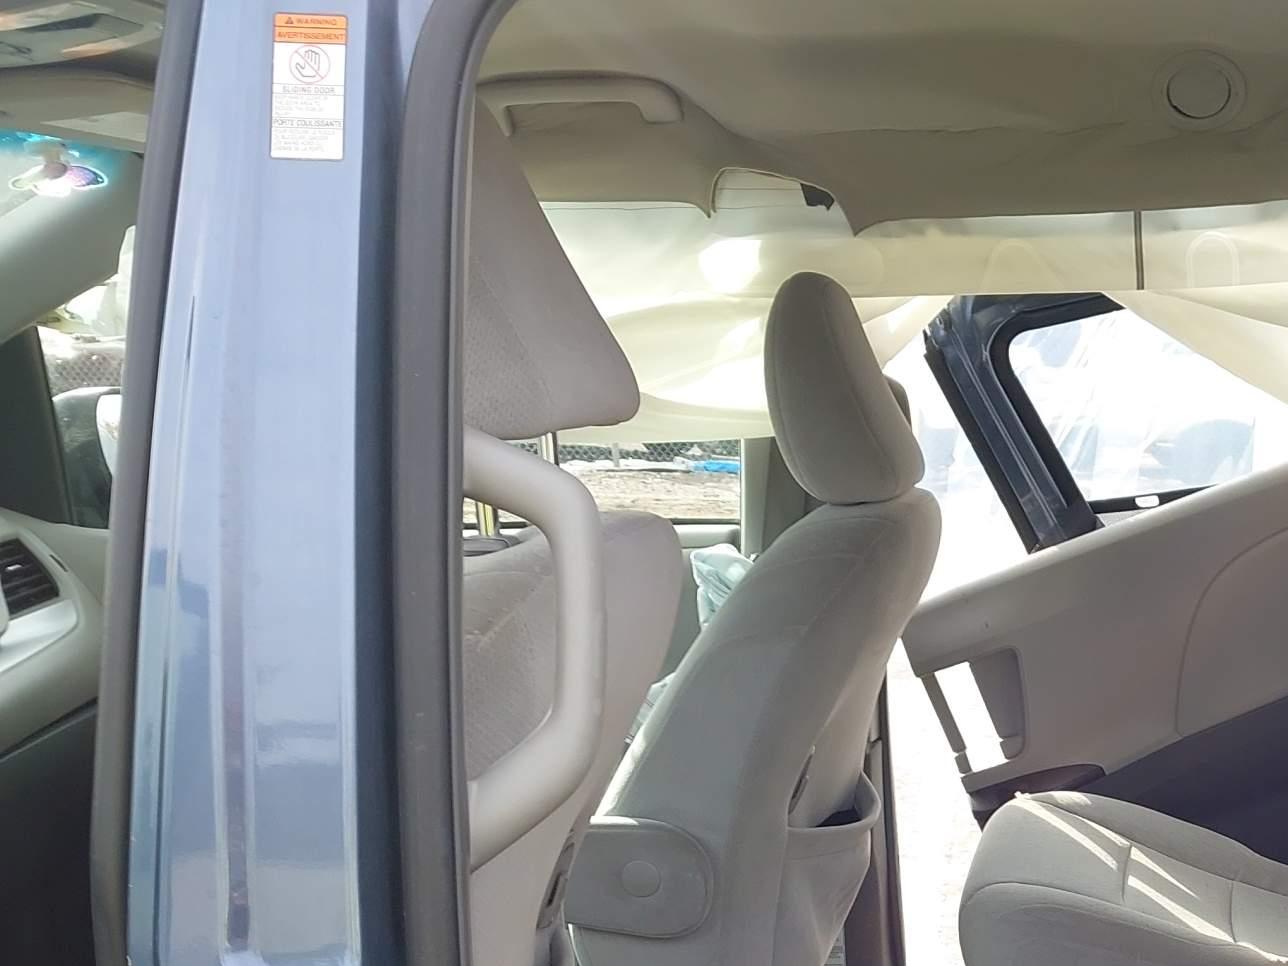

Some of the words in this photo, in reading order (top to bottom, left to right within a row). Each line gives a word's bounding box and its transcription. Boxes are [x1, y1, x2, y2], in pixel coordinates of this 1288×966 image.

[295, 18, 337, 26] WARNING
[277, 31, 345, 40] AVERTISSEMENT
[282, 85, 312, 93] SLIDING
[314, 86, 336, 94] DOOR
